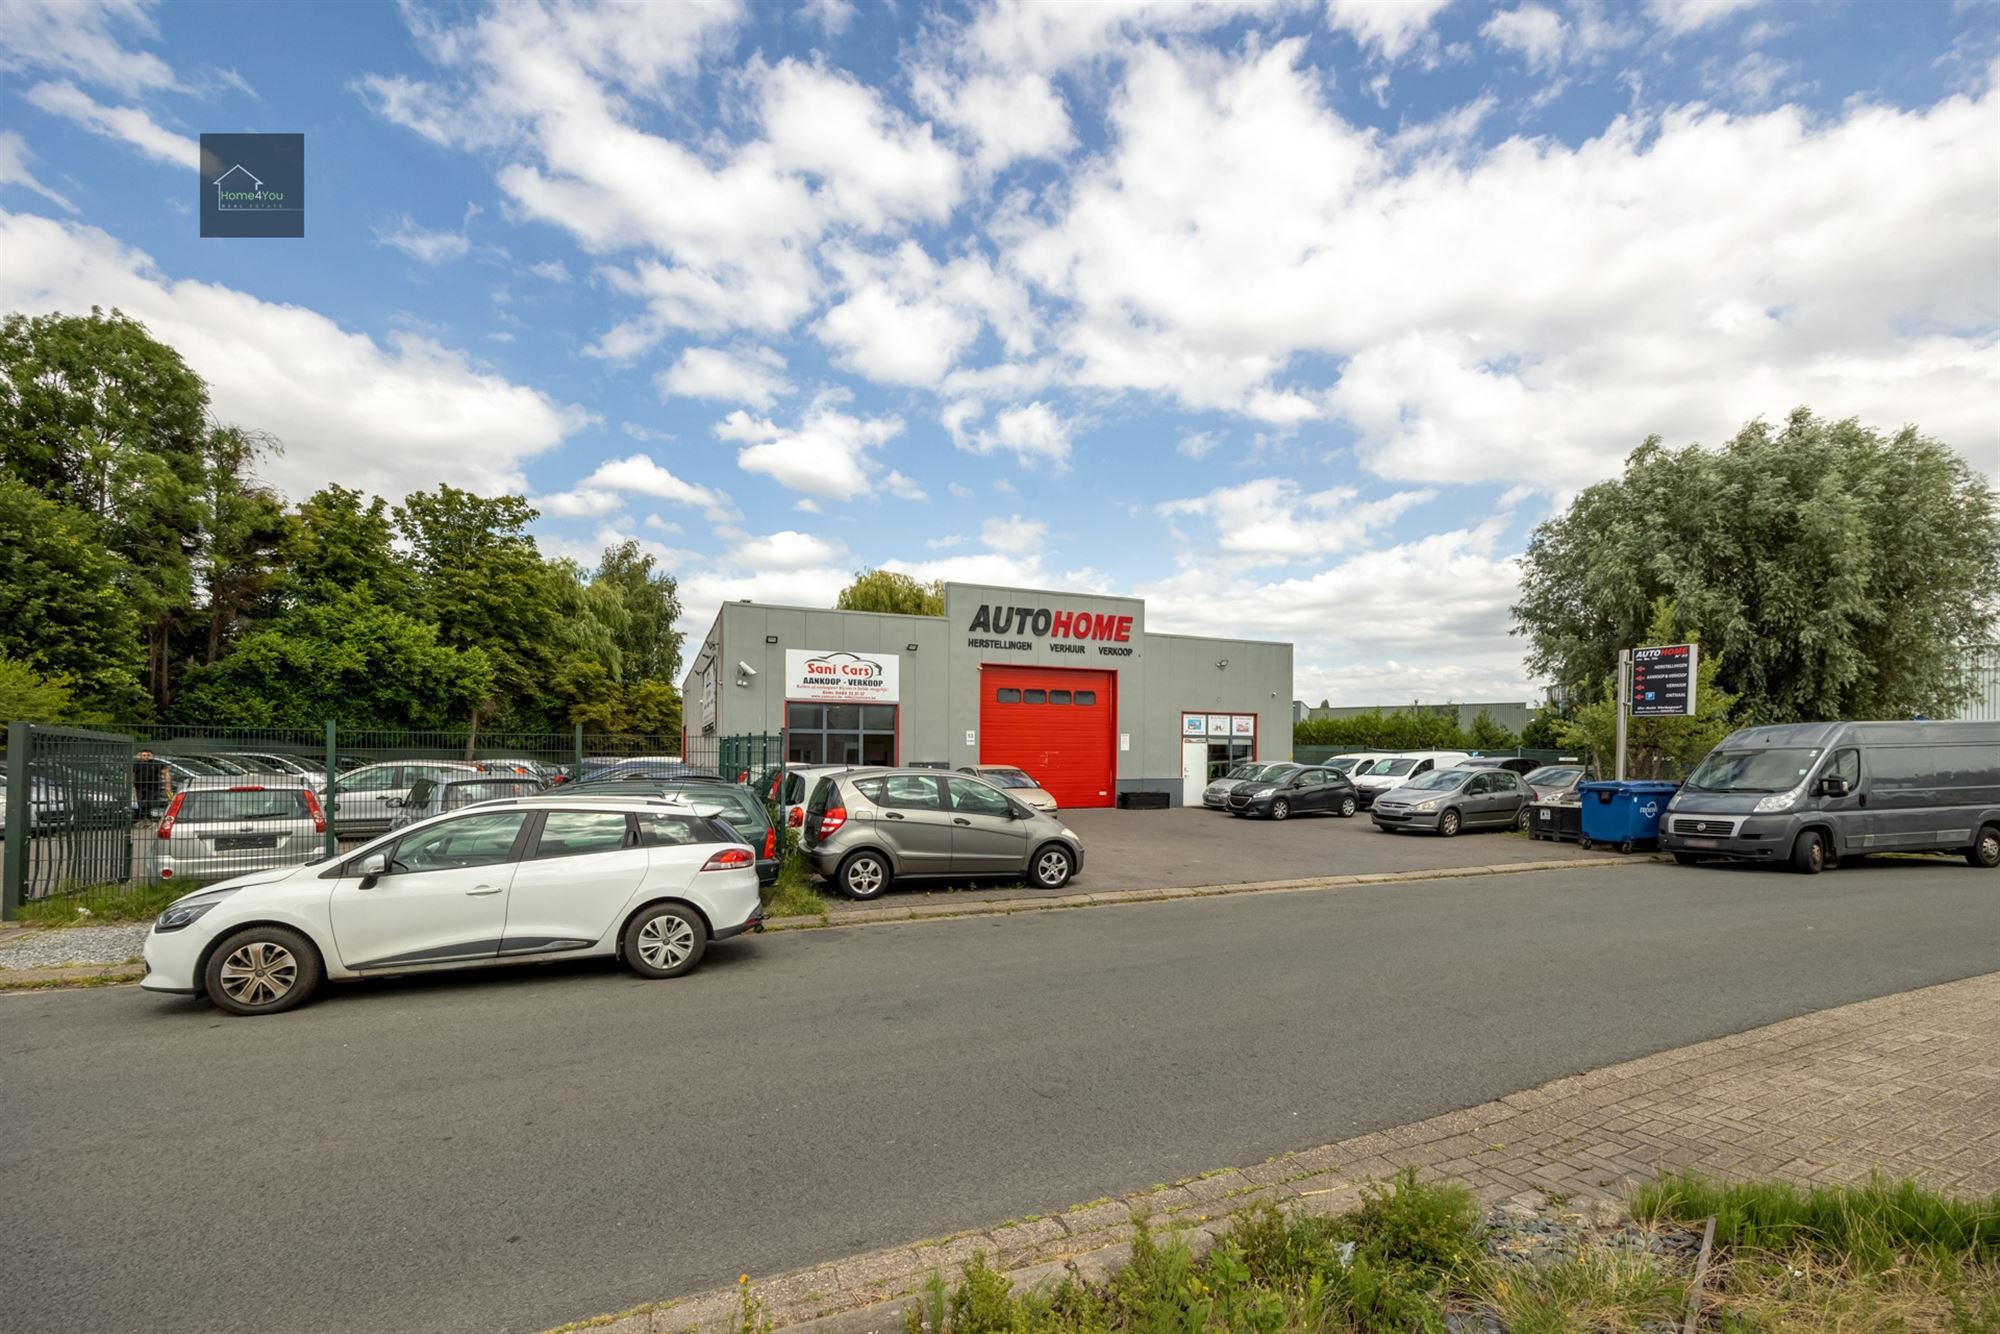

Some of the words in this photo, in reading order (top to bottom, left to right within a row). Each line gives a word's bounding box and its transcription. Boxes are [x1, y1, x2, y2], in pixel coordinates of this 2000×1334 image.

[968, 604, 1134, 642] AUTOHOME
[968, 638, 1032, 651] HERSTELLINGEN
[1050, 643, 1086, 654] VERHUUR
[1098, 646, 1133, 657] VERKOOP
[1636, 647, 1688, 658] AUTOHOME
[807, 662, 836, 674] Sani
[842, 664, 870, 676] Cars
[803, 676, 841, 686] AANKOOP
[848, 678, 884, 687] VERKOOP
